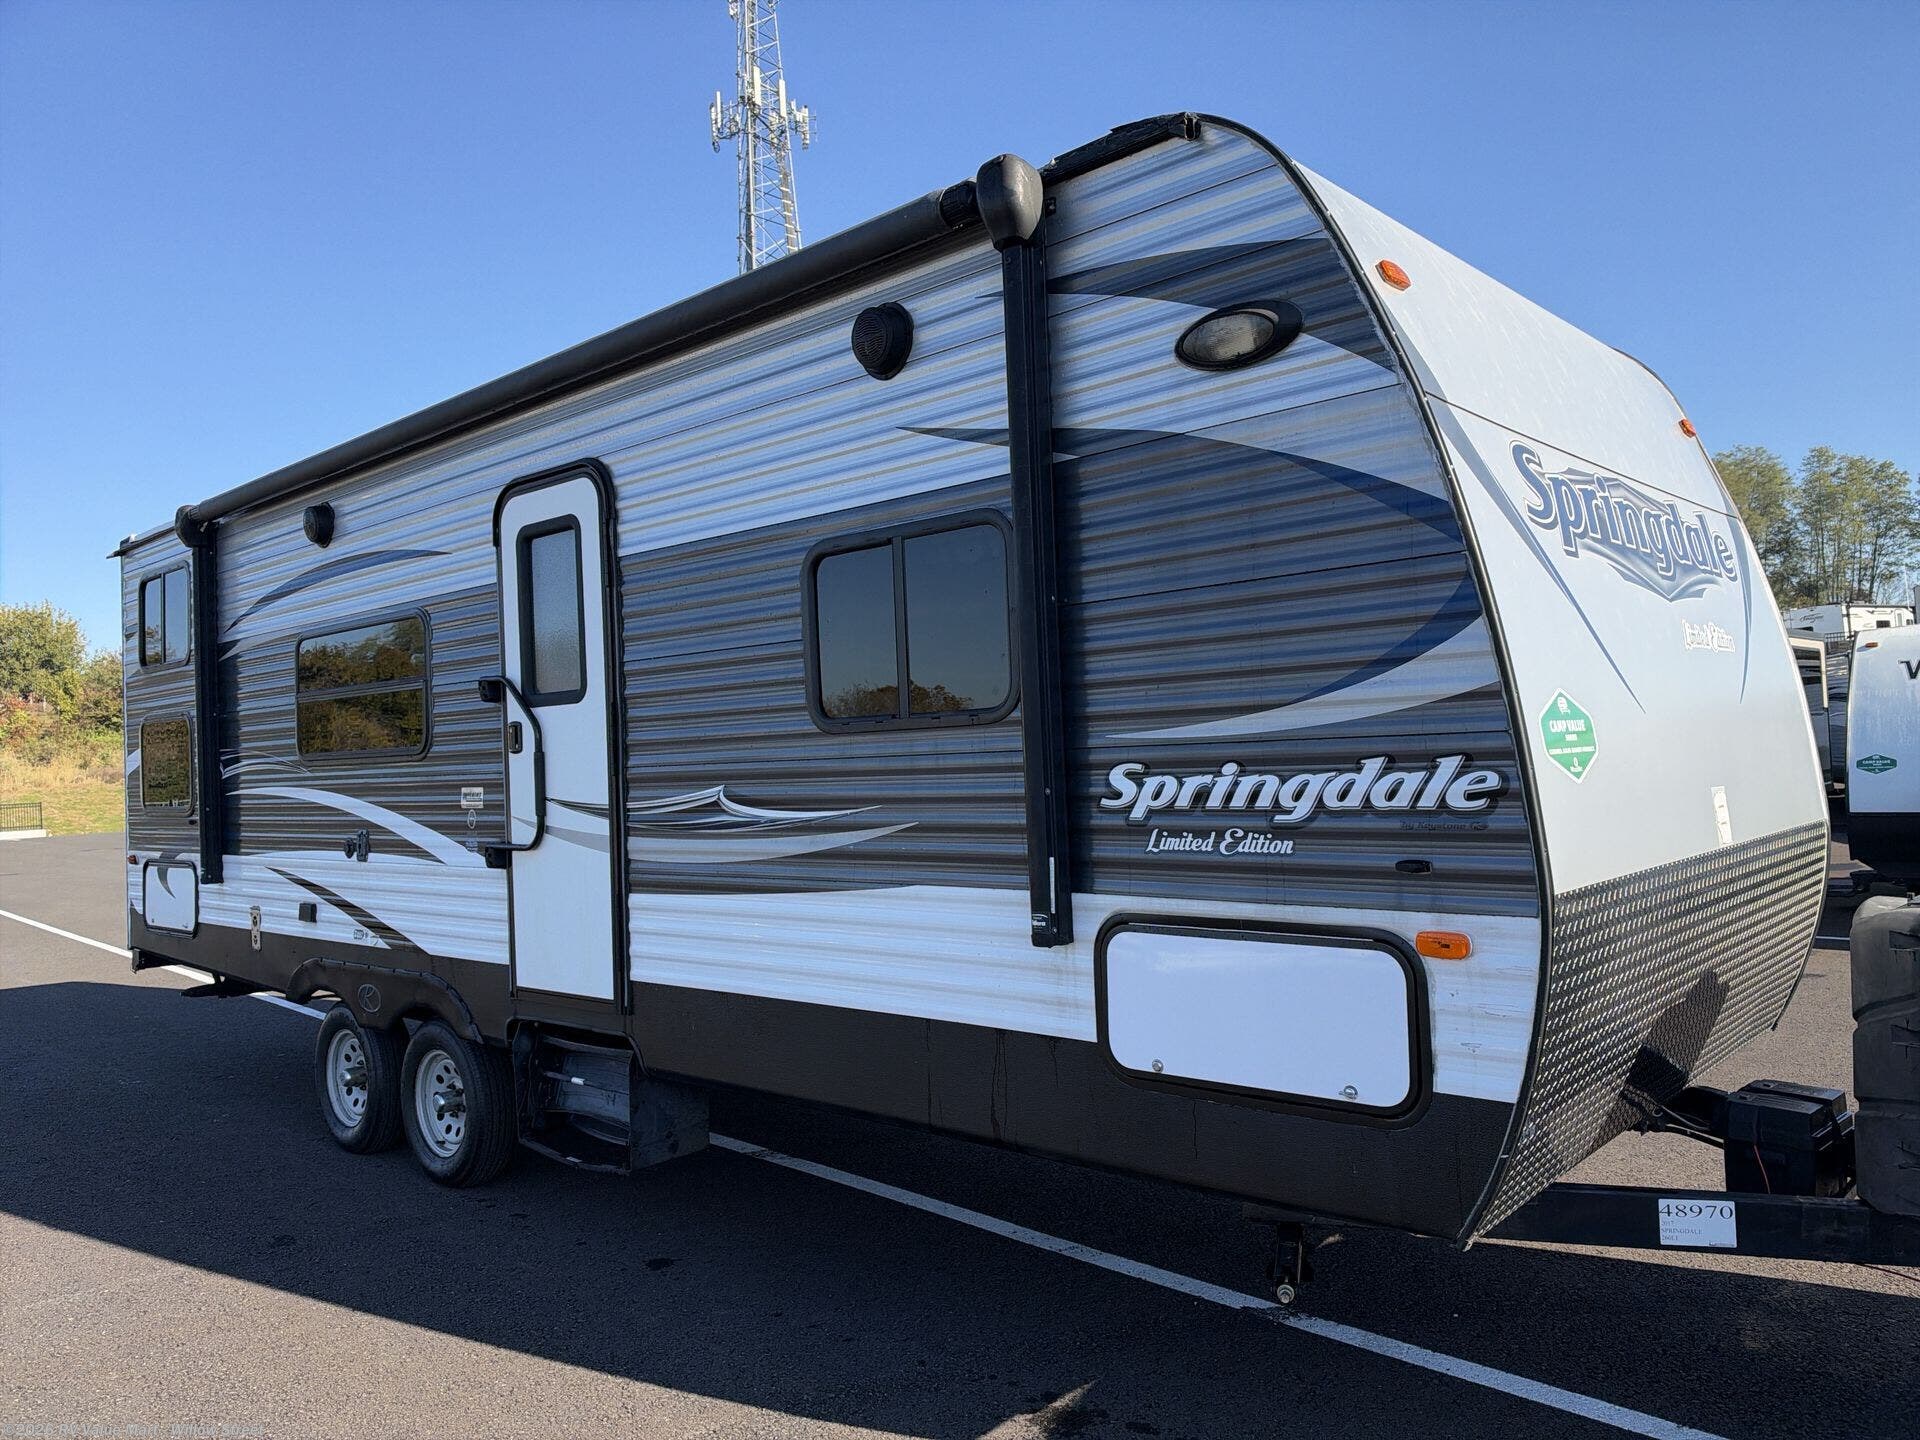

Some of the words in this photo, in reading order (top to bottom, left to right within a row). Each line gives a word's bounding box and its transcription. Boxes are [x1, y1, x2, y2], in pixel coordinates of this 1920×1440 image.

[1508, 440, 1738, 583] Springdale
[1099, 754, 1502, 824] Springdale
[1146, 828, 1216, 853] Limited
[1219, 827, 1294, 855] Edition
[1659, 1203, 1733, 1220] 48970
